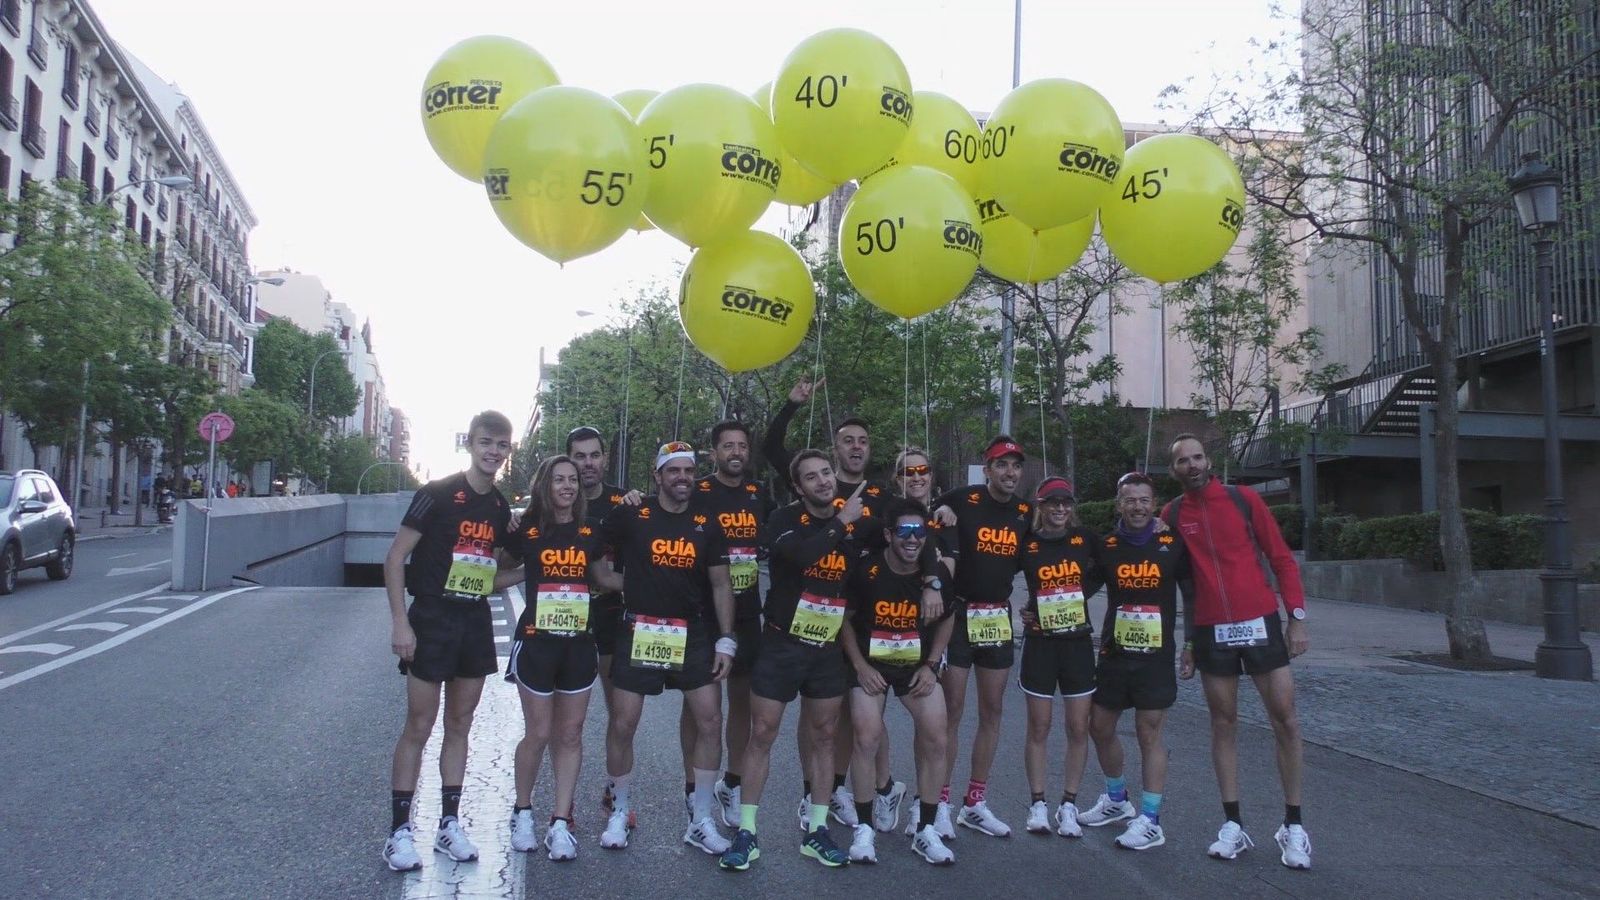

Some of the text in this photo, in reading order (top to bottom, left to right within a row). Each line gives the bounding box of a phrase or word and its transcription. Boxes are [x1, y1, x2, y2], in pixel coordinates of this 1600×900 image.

[425, 85, 501, 112] correr
[795, 75, 847, 108] 40'
[644, 134, 674, 169] 5'
[944, 129, 981, 164] 60'
[982, 125, 1015, 159] 60'
[721, 151, 782, 184] corre
[581, 169, 633, 206] 55'
[1121, 167, 1168, 203] 45'
[856, 216, 904, 256] 50'
[722, 291, 793, 321] correr
[718, 509, 757, 527] GUÍA
[460, 520, 494, 541] GUÍA
[978, 526, 1018, 546] GUÍA
[540, 546, 587, 566] GUÍA
[651, 537, 696, 558] GUÍA
[976, 541, 1016, 556] PACER
[652, 554, 695, 568] PACER
[813, 550, 846, 571] UÍA
[1038, 559, 1081, 580] GUÍA
[1117, 560, 1161, 578] GUÍA
[543, 565, 584, 577] PACER
[460, 576, 484, 592] 40109
[1041, 575, 1081, 590] PACER
[1118, 577, 1160, 589] PACER
[875, 600, 918, 618] GUÍA
[547, 613, 579, 628] F40478
[875, 616, 917, 629] PACER
[1049, 611, 1077, 627] F43640
[979, 628, 1001, 640] 41671
[1124, 631, 1150, 645] 44064
[1227, 625, 1254, 639] 20909
[644, 644, 672, 660] 41309
